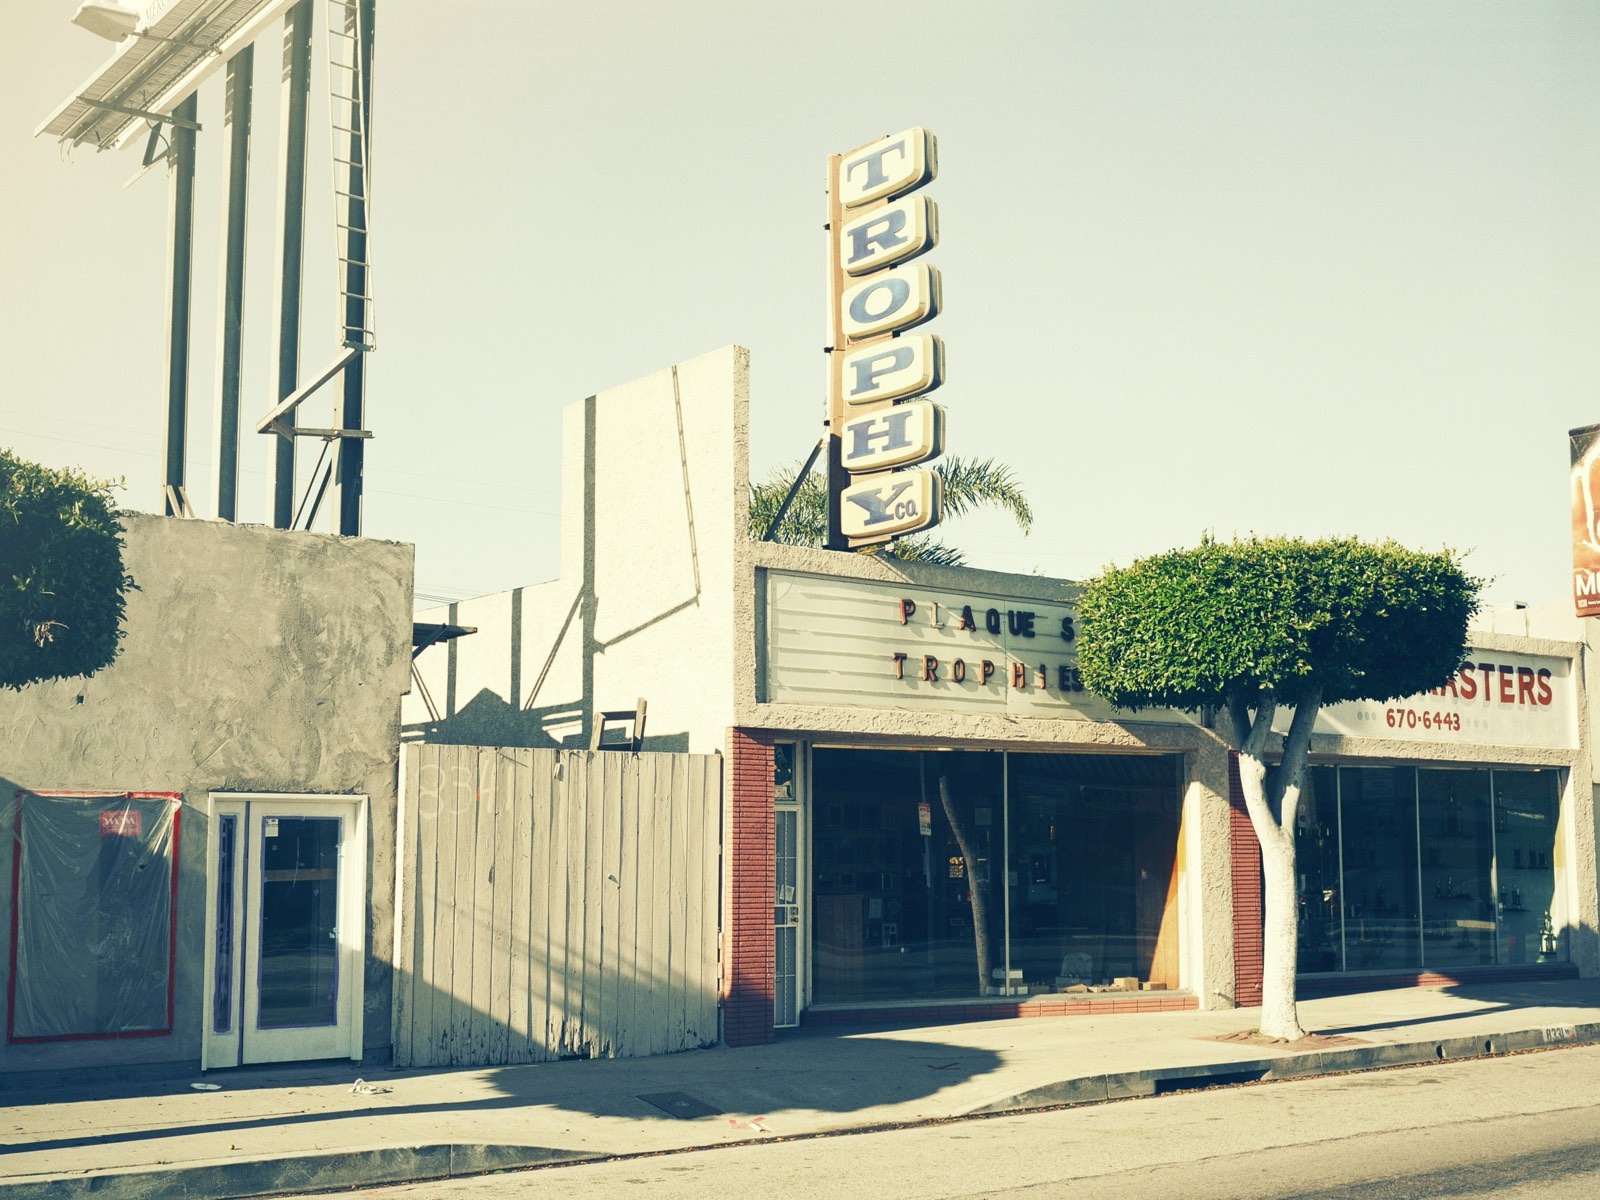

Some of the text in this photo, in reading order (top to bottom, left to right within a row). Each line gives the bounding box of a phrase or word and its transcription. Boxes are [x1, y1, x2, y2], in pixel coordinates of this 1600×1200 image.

[847, 139, 918, 526] TROPHY CO.
[892, 652, 1083, 692] TROPHIES
[1430, 661, 1552, 705] ASTERS
